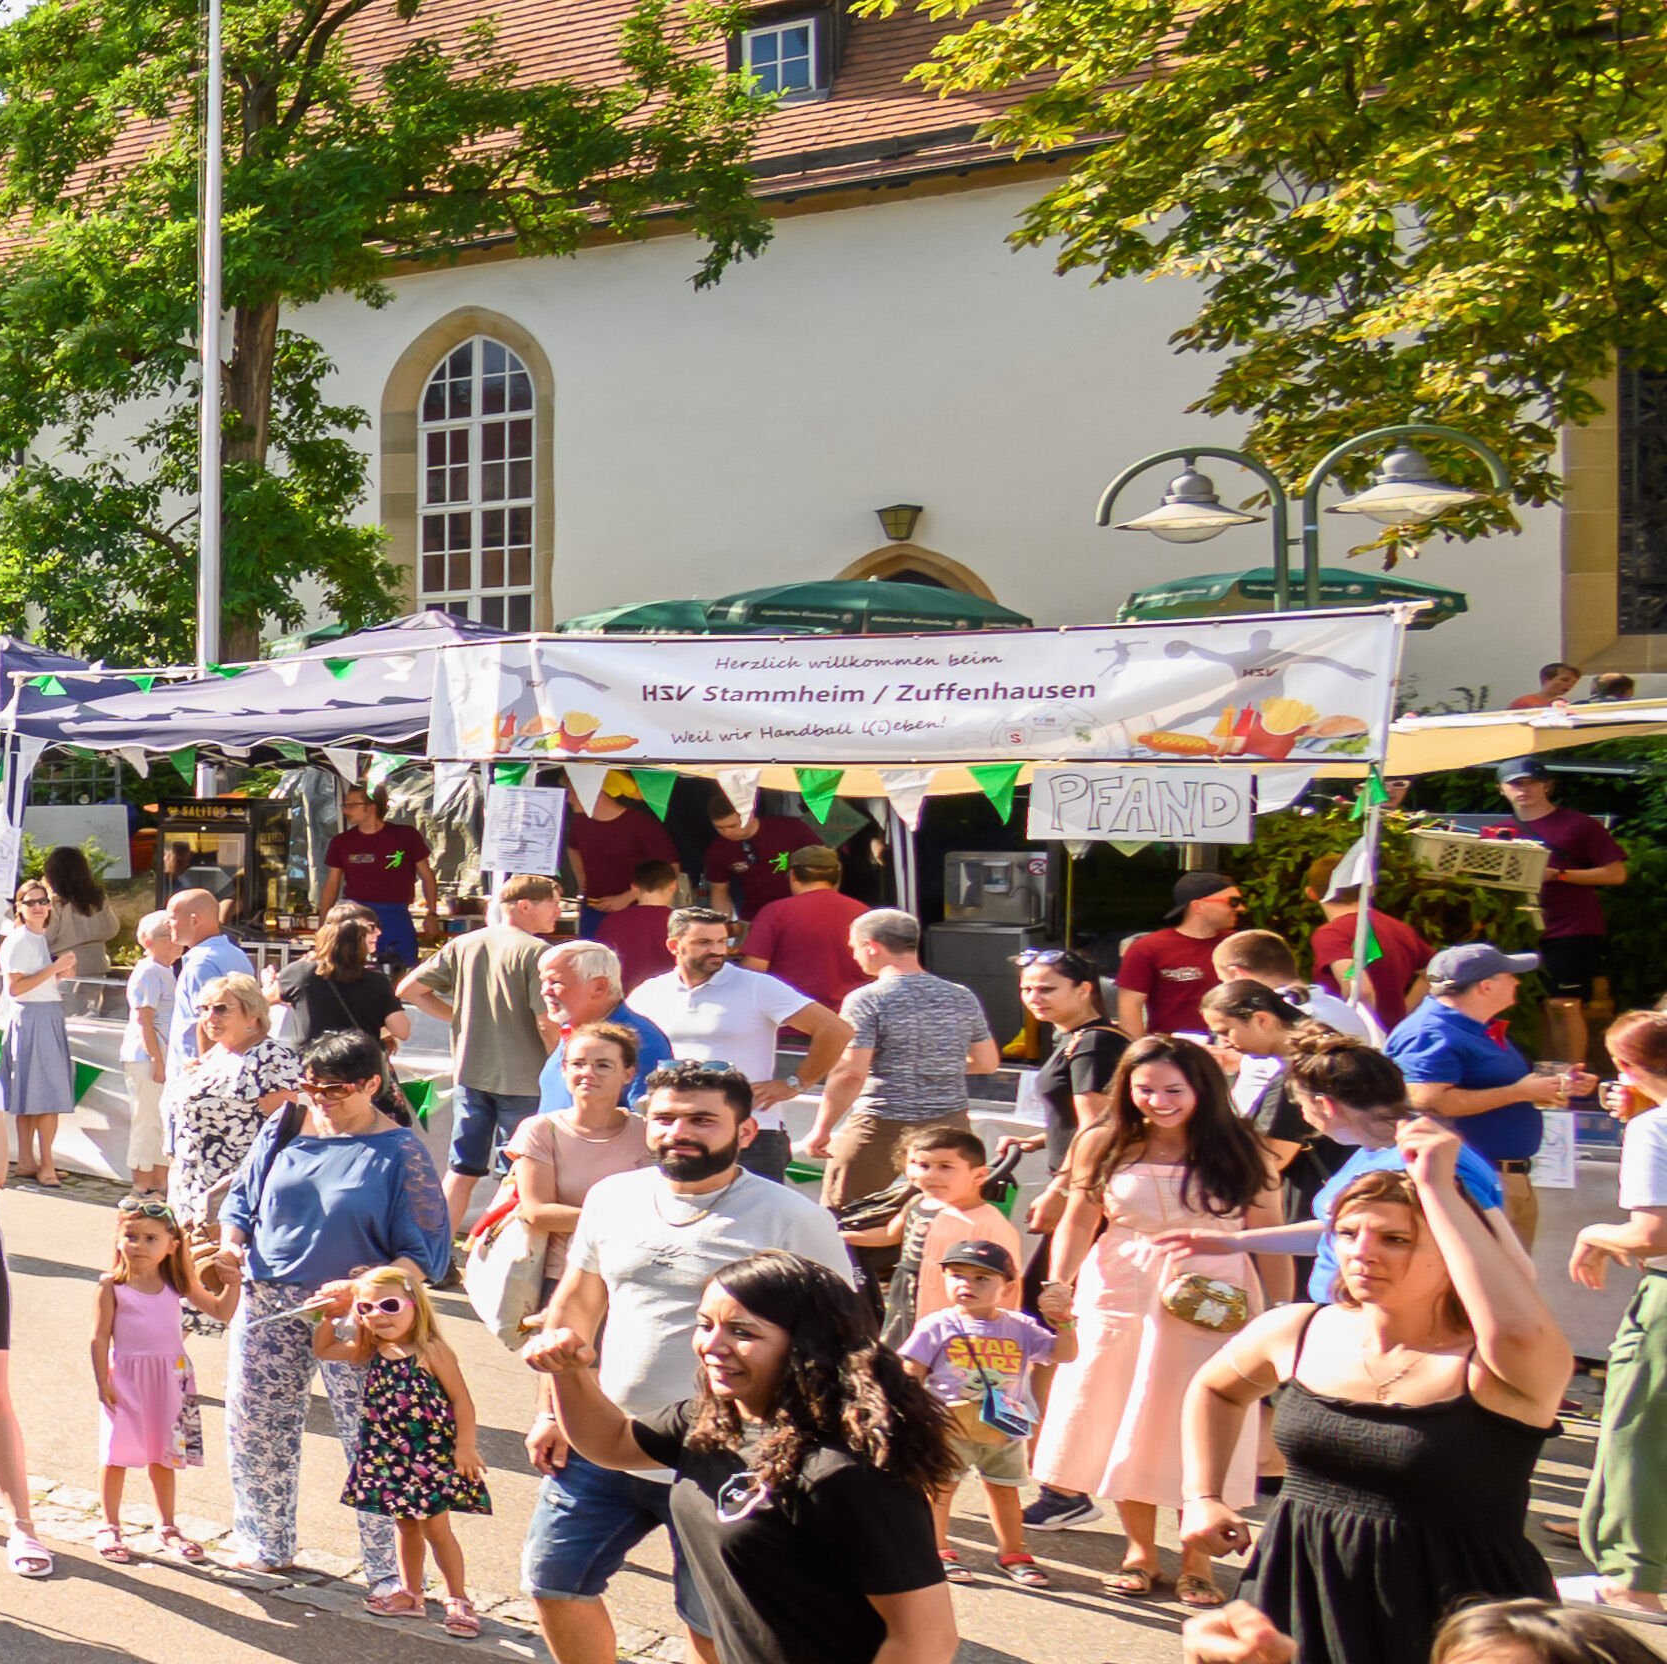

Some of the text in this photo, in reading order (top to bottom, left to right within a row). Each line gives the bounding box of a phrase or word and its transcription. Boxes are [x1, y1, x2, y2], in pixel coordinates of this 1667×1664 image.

[715, 651, 1003, 671] Herzlich willkommen beim
[642, 684, 696, 702] HSV
[702, 684, 865, 703] Stammheim
[895, 681, 1097, 702] Zuffenhausen
[671, 728, 714, 745] Weil
[719, 730, 753, 742] wir
[760, 721, 856, 740] Handball
[181, 805, 228, 818] SALITOS
[1049, 773, 1240, 838] PFAND
[947, 1337, 1023, 1357] STAR
[948, 1353, 1023, 1376] WARS
